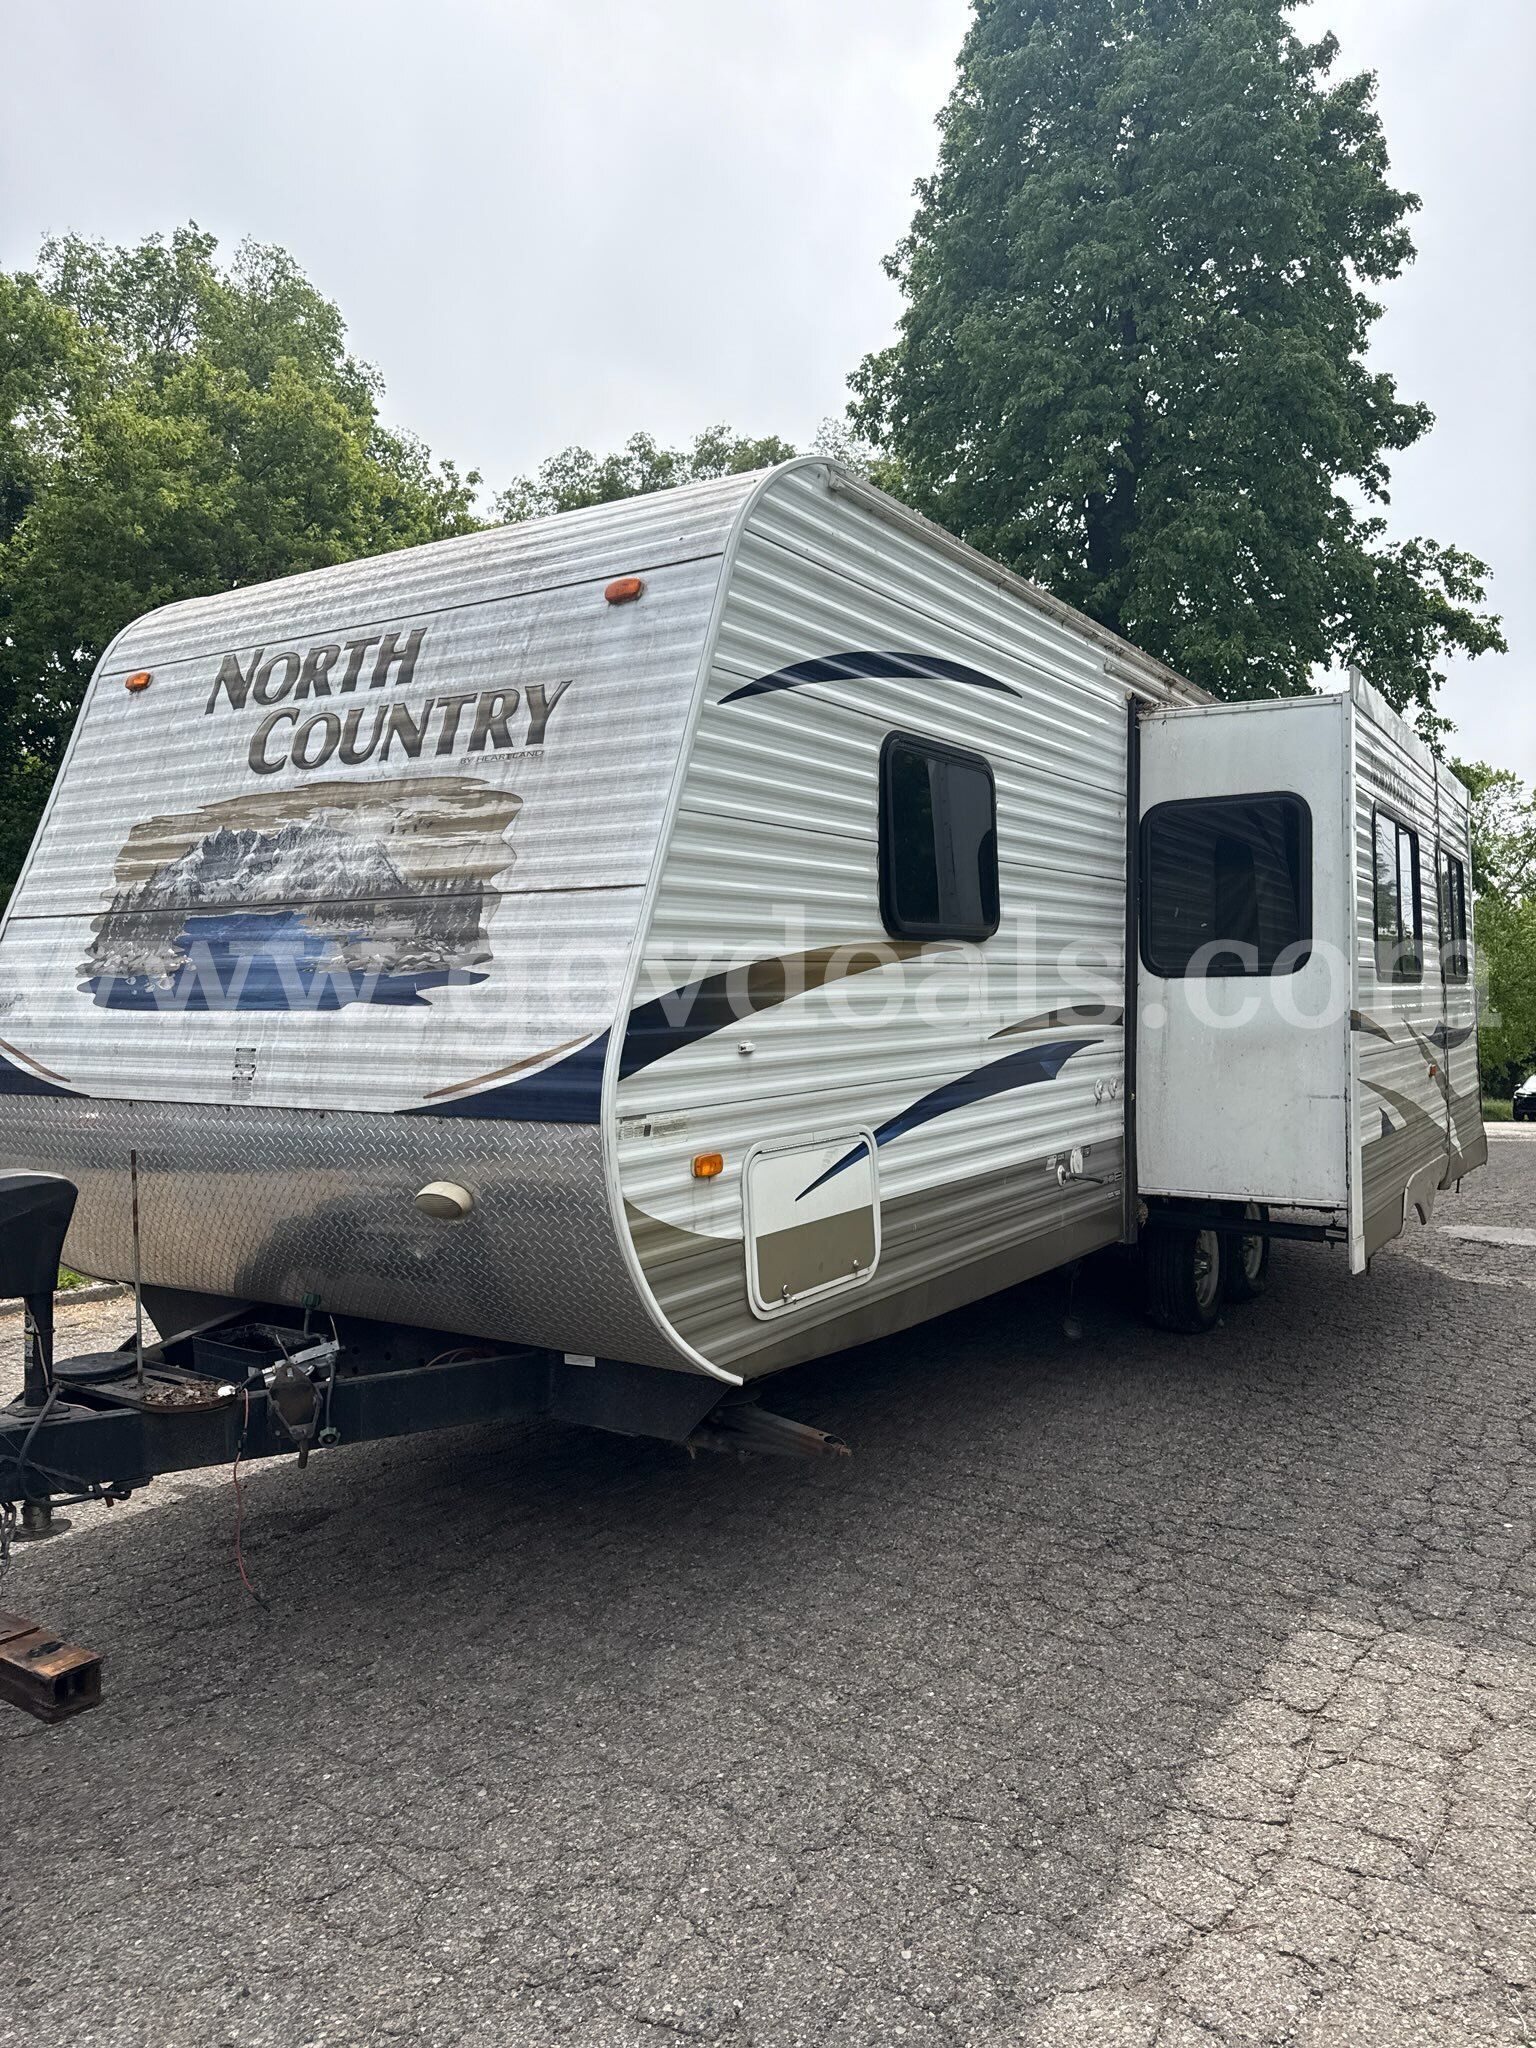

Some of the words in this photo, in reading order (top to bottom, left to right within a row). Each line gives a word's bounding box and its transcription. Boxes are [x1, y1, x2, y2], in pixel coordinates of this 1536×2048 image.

[205, 627, 428, 715] NORTH
[248, 680, 573, 775] COUNTRY
[460, 757, 473, 765] BY
[476, 749, 545, 763] HEARTLAND
